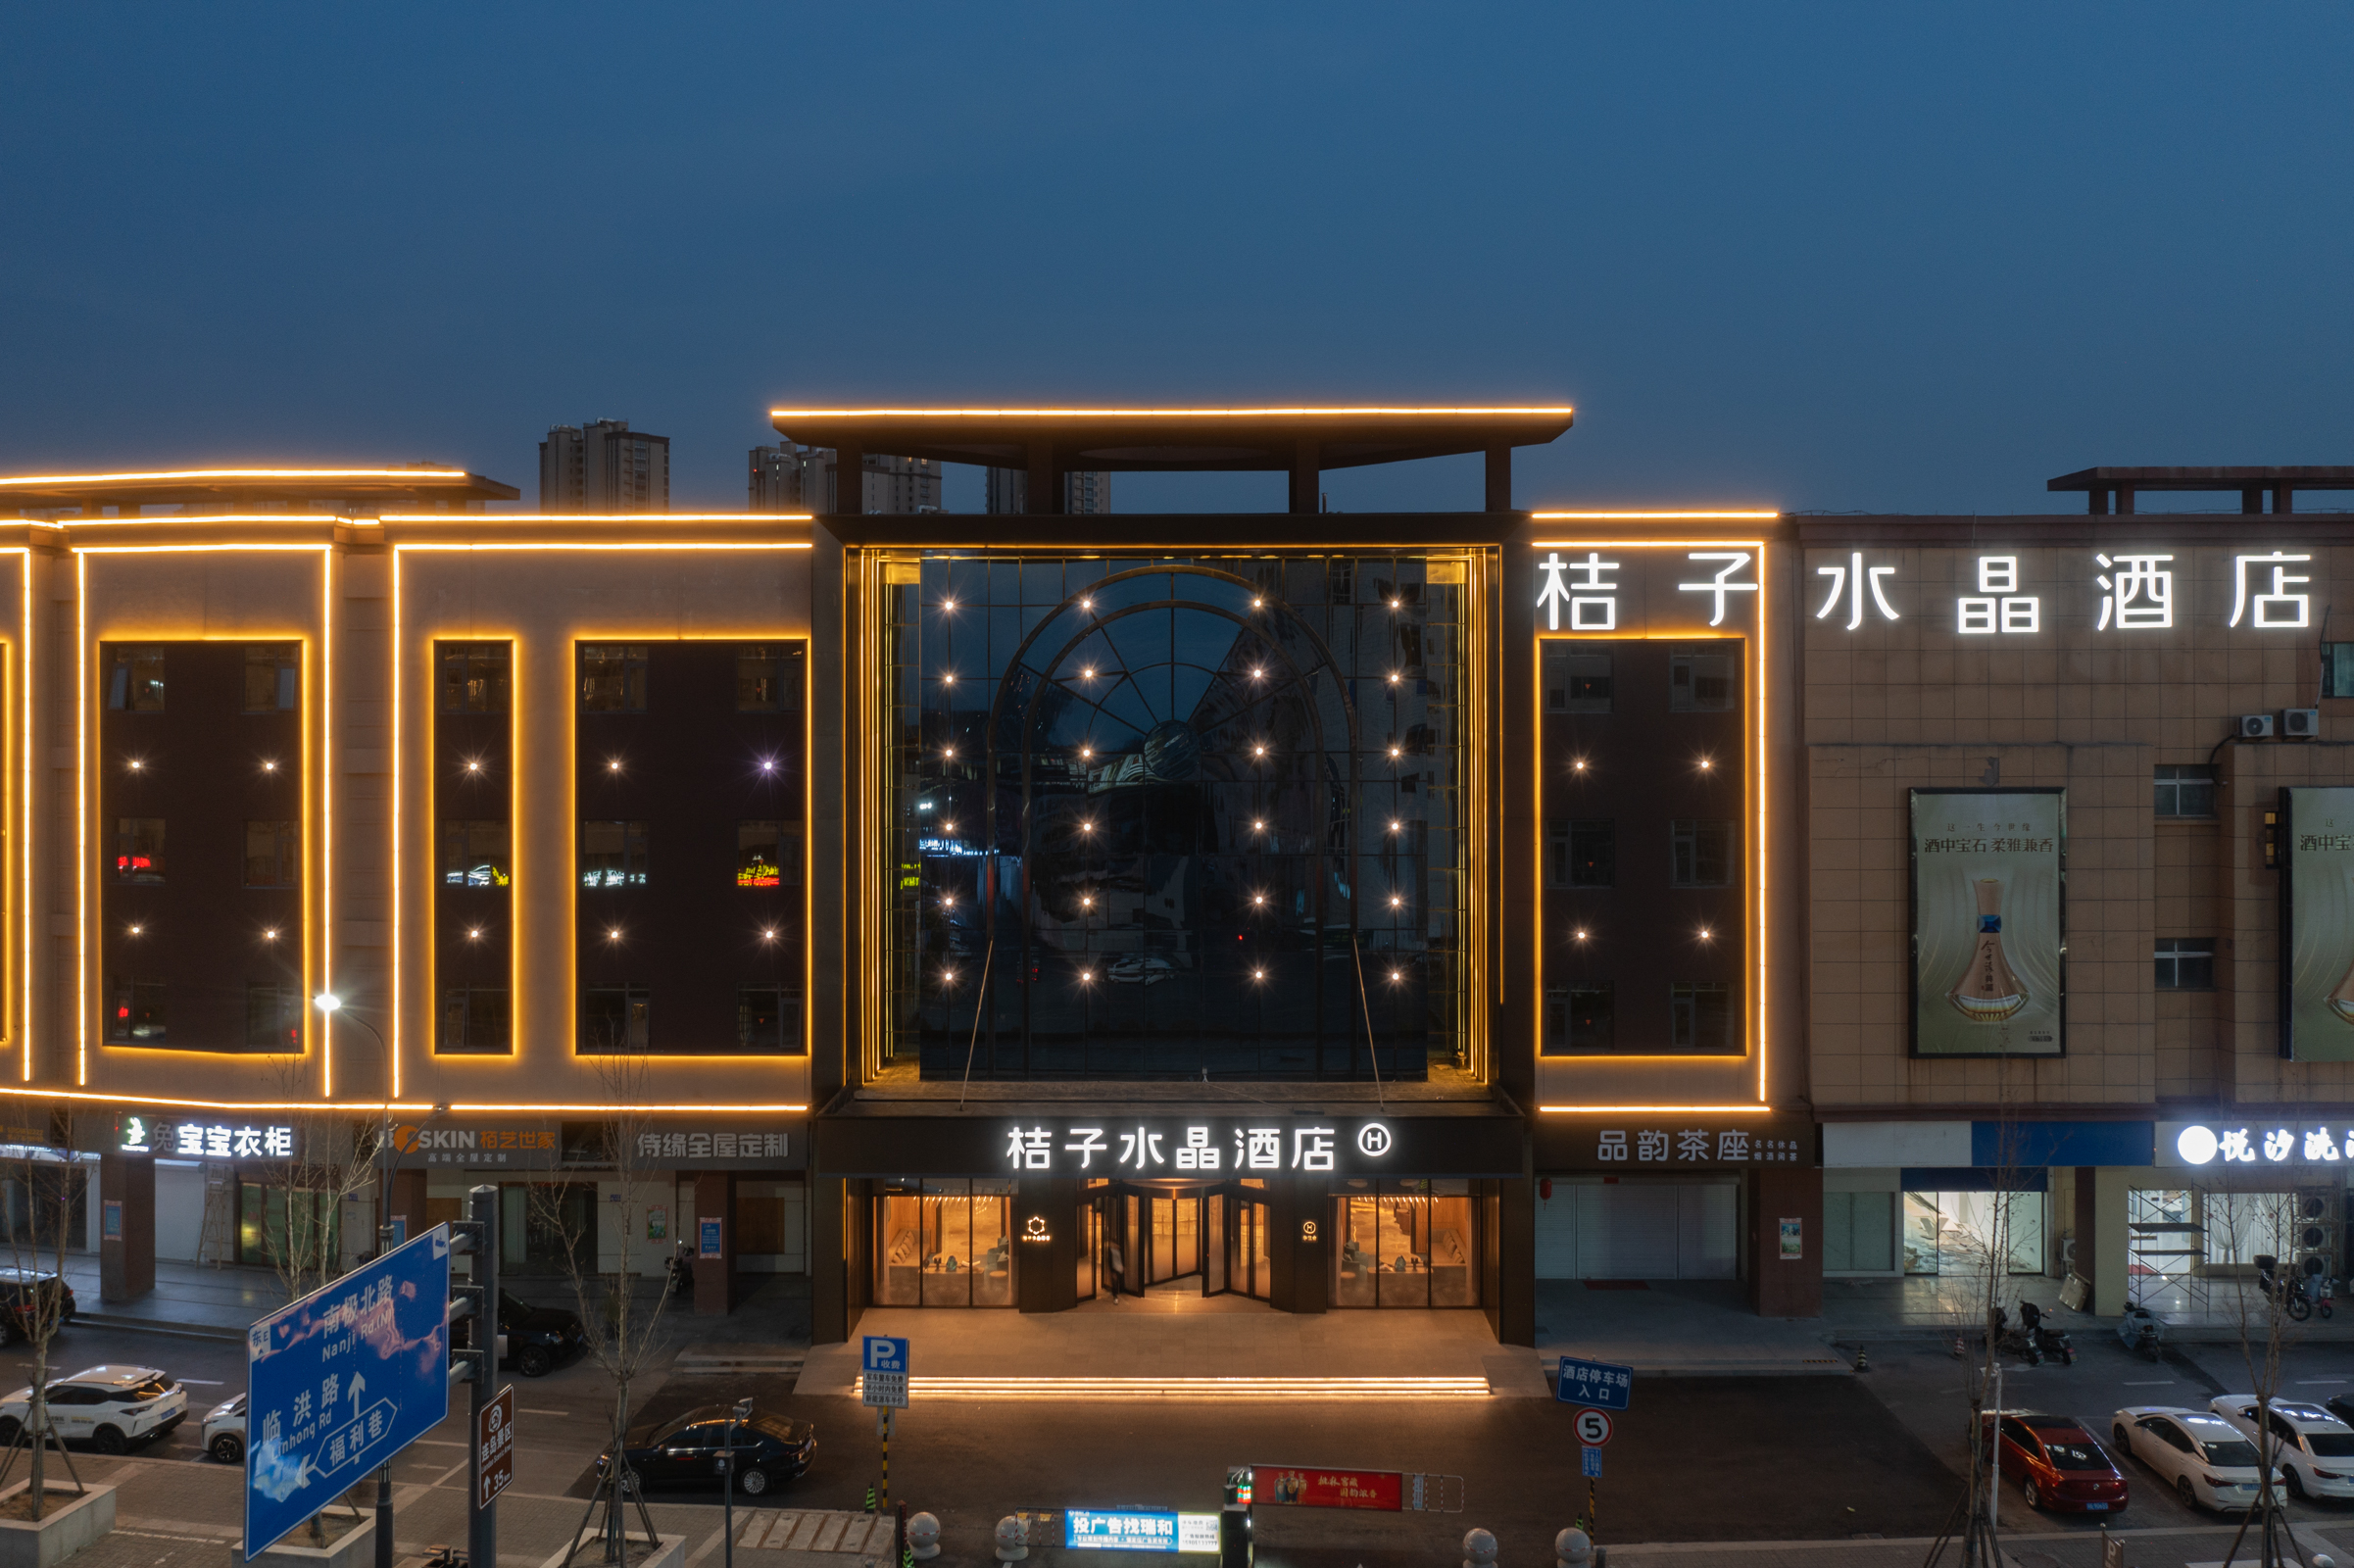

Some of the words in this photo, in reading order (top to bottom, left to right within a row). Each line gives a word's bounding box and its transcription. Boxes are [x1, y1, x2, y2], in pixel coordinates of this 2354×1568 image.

[1537, 551, 2311, 634] 桔子水晶酒店
[1924, 838, 1986, 853] 酒中宝石
[1990, 838, 2053, 853] 柔雅兼香
[2300, 834, 2354, 852] 酒中宝
[152, 1122, 293, 1157] 兔宝宝衣柜
[1006, 1126, 1335, 1171] 桔子水晶酒店
[1597, 1128, 1749, 1161] 品韵茶座
[428, 1152, 507, 1163] 高端全屋定制
[322, 1275, 394, 1339] 南极北路
[321, 1331, 356, 1362] Nanji
[869, 1339, 897, 1368] P
[880, 1359, 901, 1370] 收费
[1562, 1364, 1629, 1388] 酒店停车场
[1578, 1384, 1610, 1400] 入口
[263, 1373, 339, 1445] 临洪路
[319, 1408, 332, 1431] Rd
[329, 1409, 383, 1467] 福利巷
[1585, 1417, 1603, 1439] 5
[493, 1469, 504, 1491] 35
[1073, 1516, 1173, 1536] 投广告找瑞和
